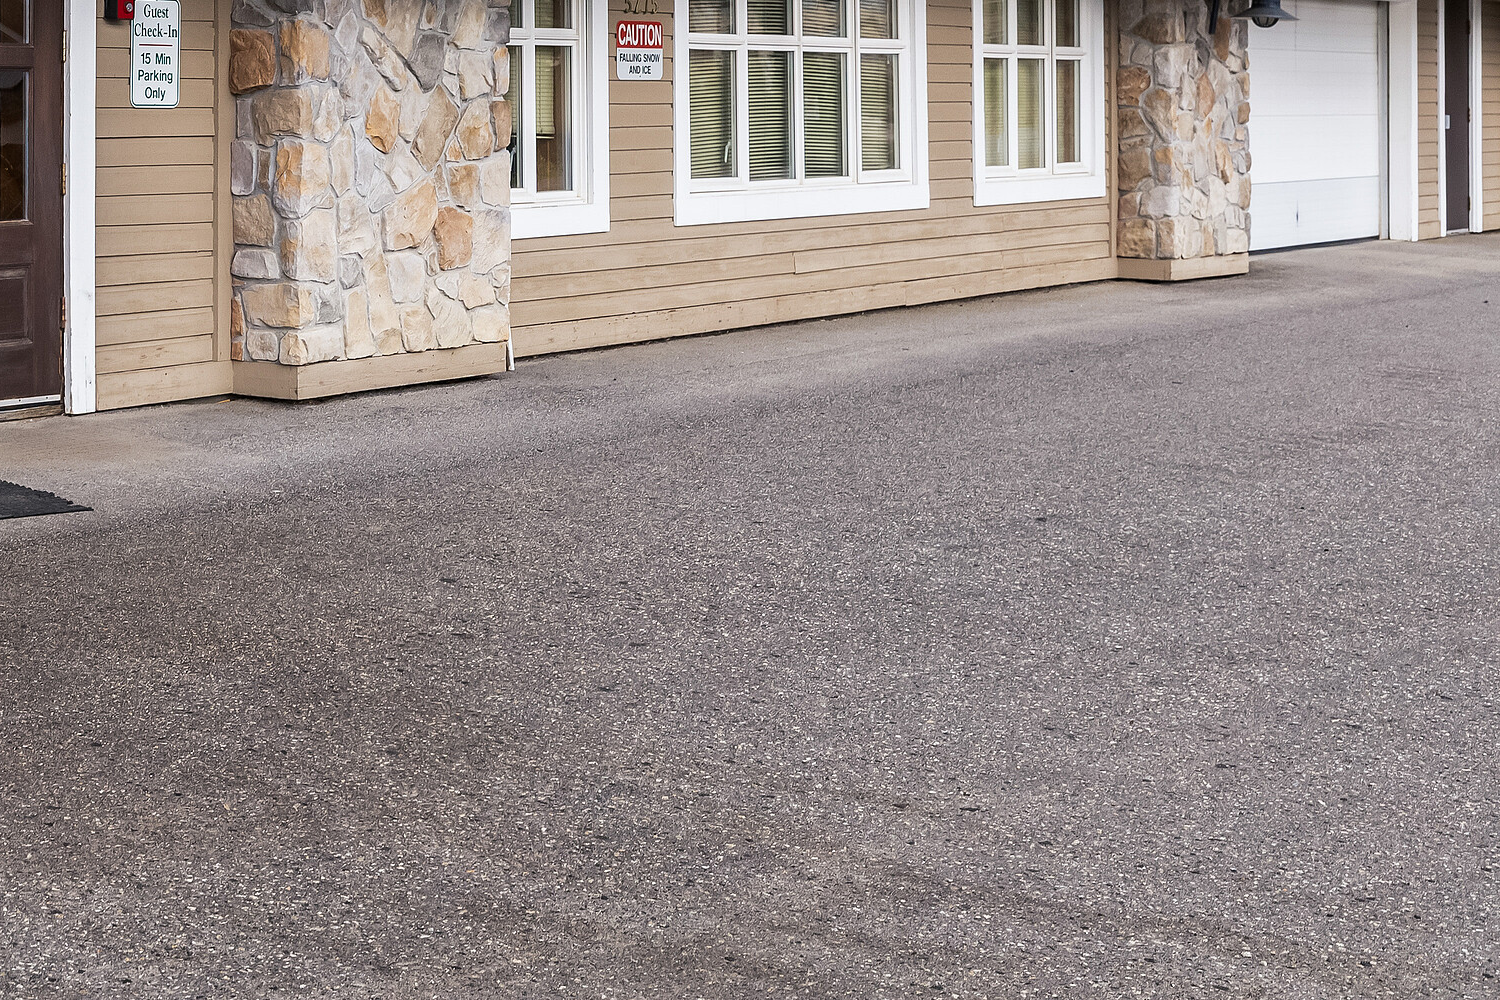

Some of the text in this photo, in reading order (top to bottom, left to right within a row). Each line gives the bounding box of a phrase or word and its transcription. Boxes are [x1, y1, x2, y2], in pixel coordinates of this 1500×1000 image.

[143, 4, 169, 19] Guest
[134, 22, 178, 38] Check-In
[618, 23, 662, 46] CAUTION
[140, 52, 171, 65] 15 Min
[619, 53, 660, 63] FALLING SNOW
[137, 69, 173, 84] Parking
[629, 65, 651, 75] AND ICE
[144, 86, 166, 101] Only
